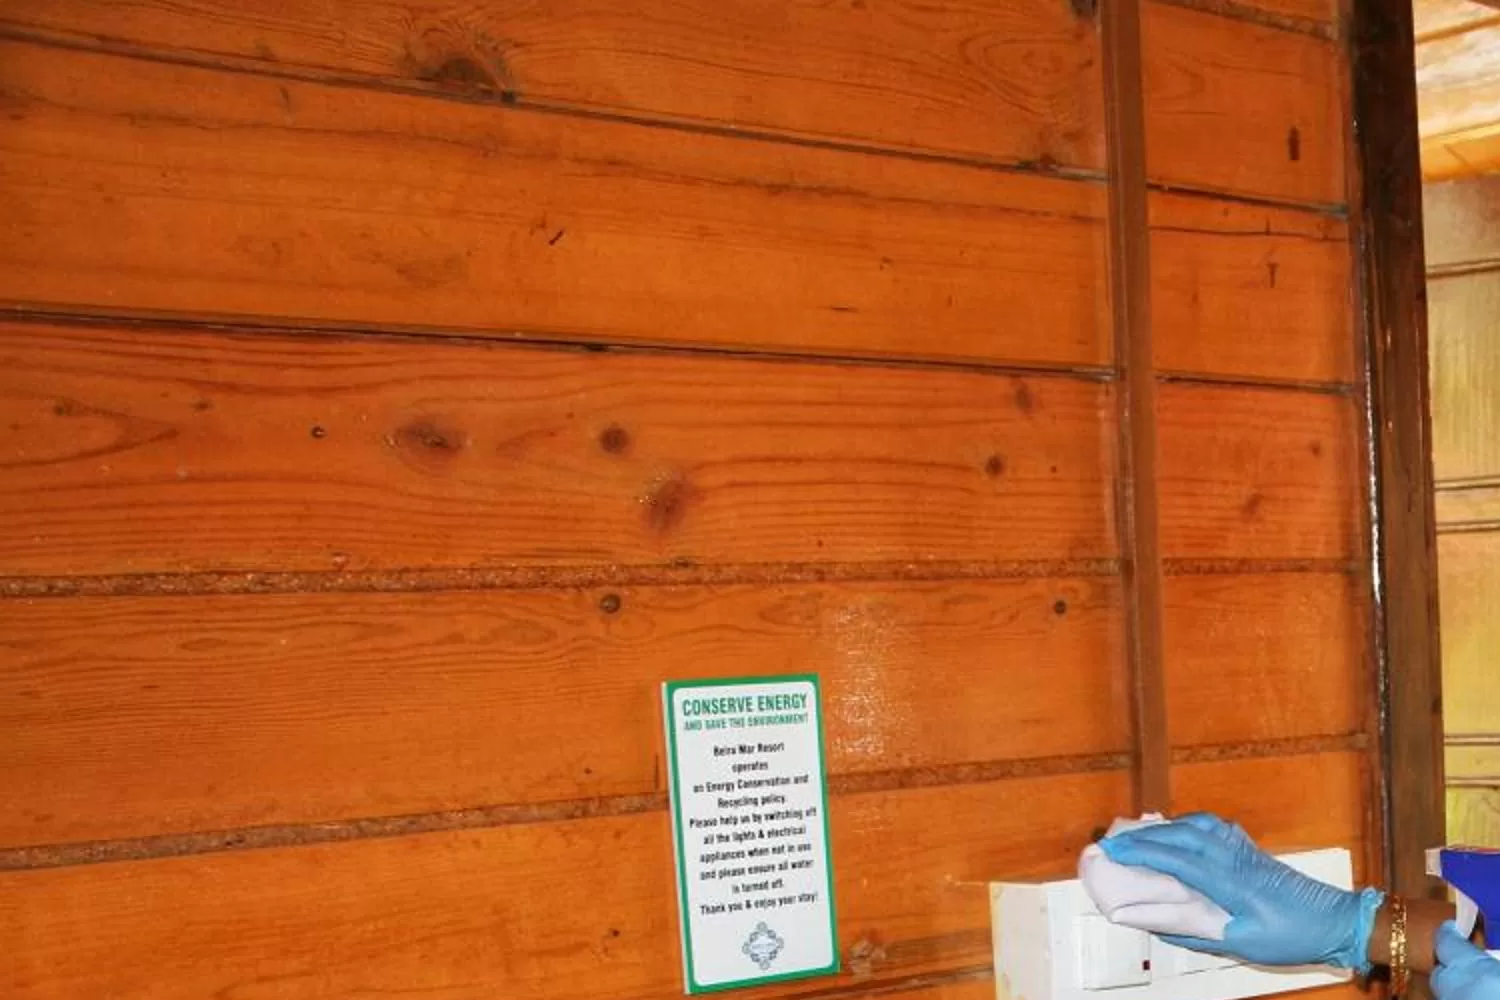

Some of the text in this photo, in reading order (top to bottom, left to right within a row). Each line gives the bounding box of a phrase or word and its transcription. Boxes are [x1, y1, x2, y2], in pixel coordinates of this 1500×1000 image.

[683, 693, 807, 716] CONSERVE ENERGY
[685, 713, 808, 730] AND SAVE THE ENVIRONMENT
[714, 742, 784, 756] Beira Mar Resort
[732, 761, 768, 773] operates
[706, 781, 734, 792] Energy
[738, 776, 790, 789] Conservation
[794, 775, 808, 784] and
[718, 796, 758, 808] Recycling
[689, 817, 717, 828] Please
[720, 816, 737, 826] help
[752, 813, 762, 824] by
[765, 810, 803, 821] switching
[704, 826, 806, 844] all the lights & electrical
[700, 843, 811, 863] appliances when not in use
[701, 859, 813, 880] and please ensure all water
[732, 884, 739, 893] is
[742, 881, 768, 892] turned
[701, 904, 725, 915] Thank
[728, 902, 742, 912] you
[746, 900, 752, 908] &
[754, 899, 776, 910] enjoy
[778, 896, 796, 906] your
